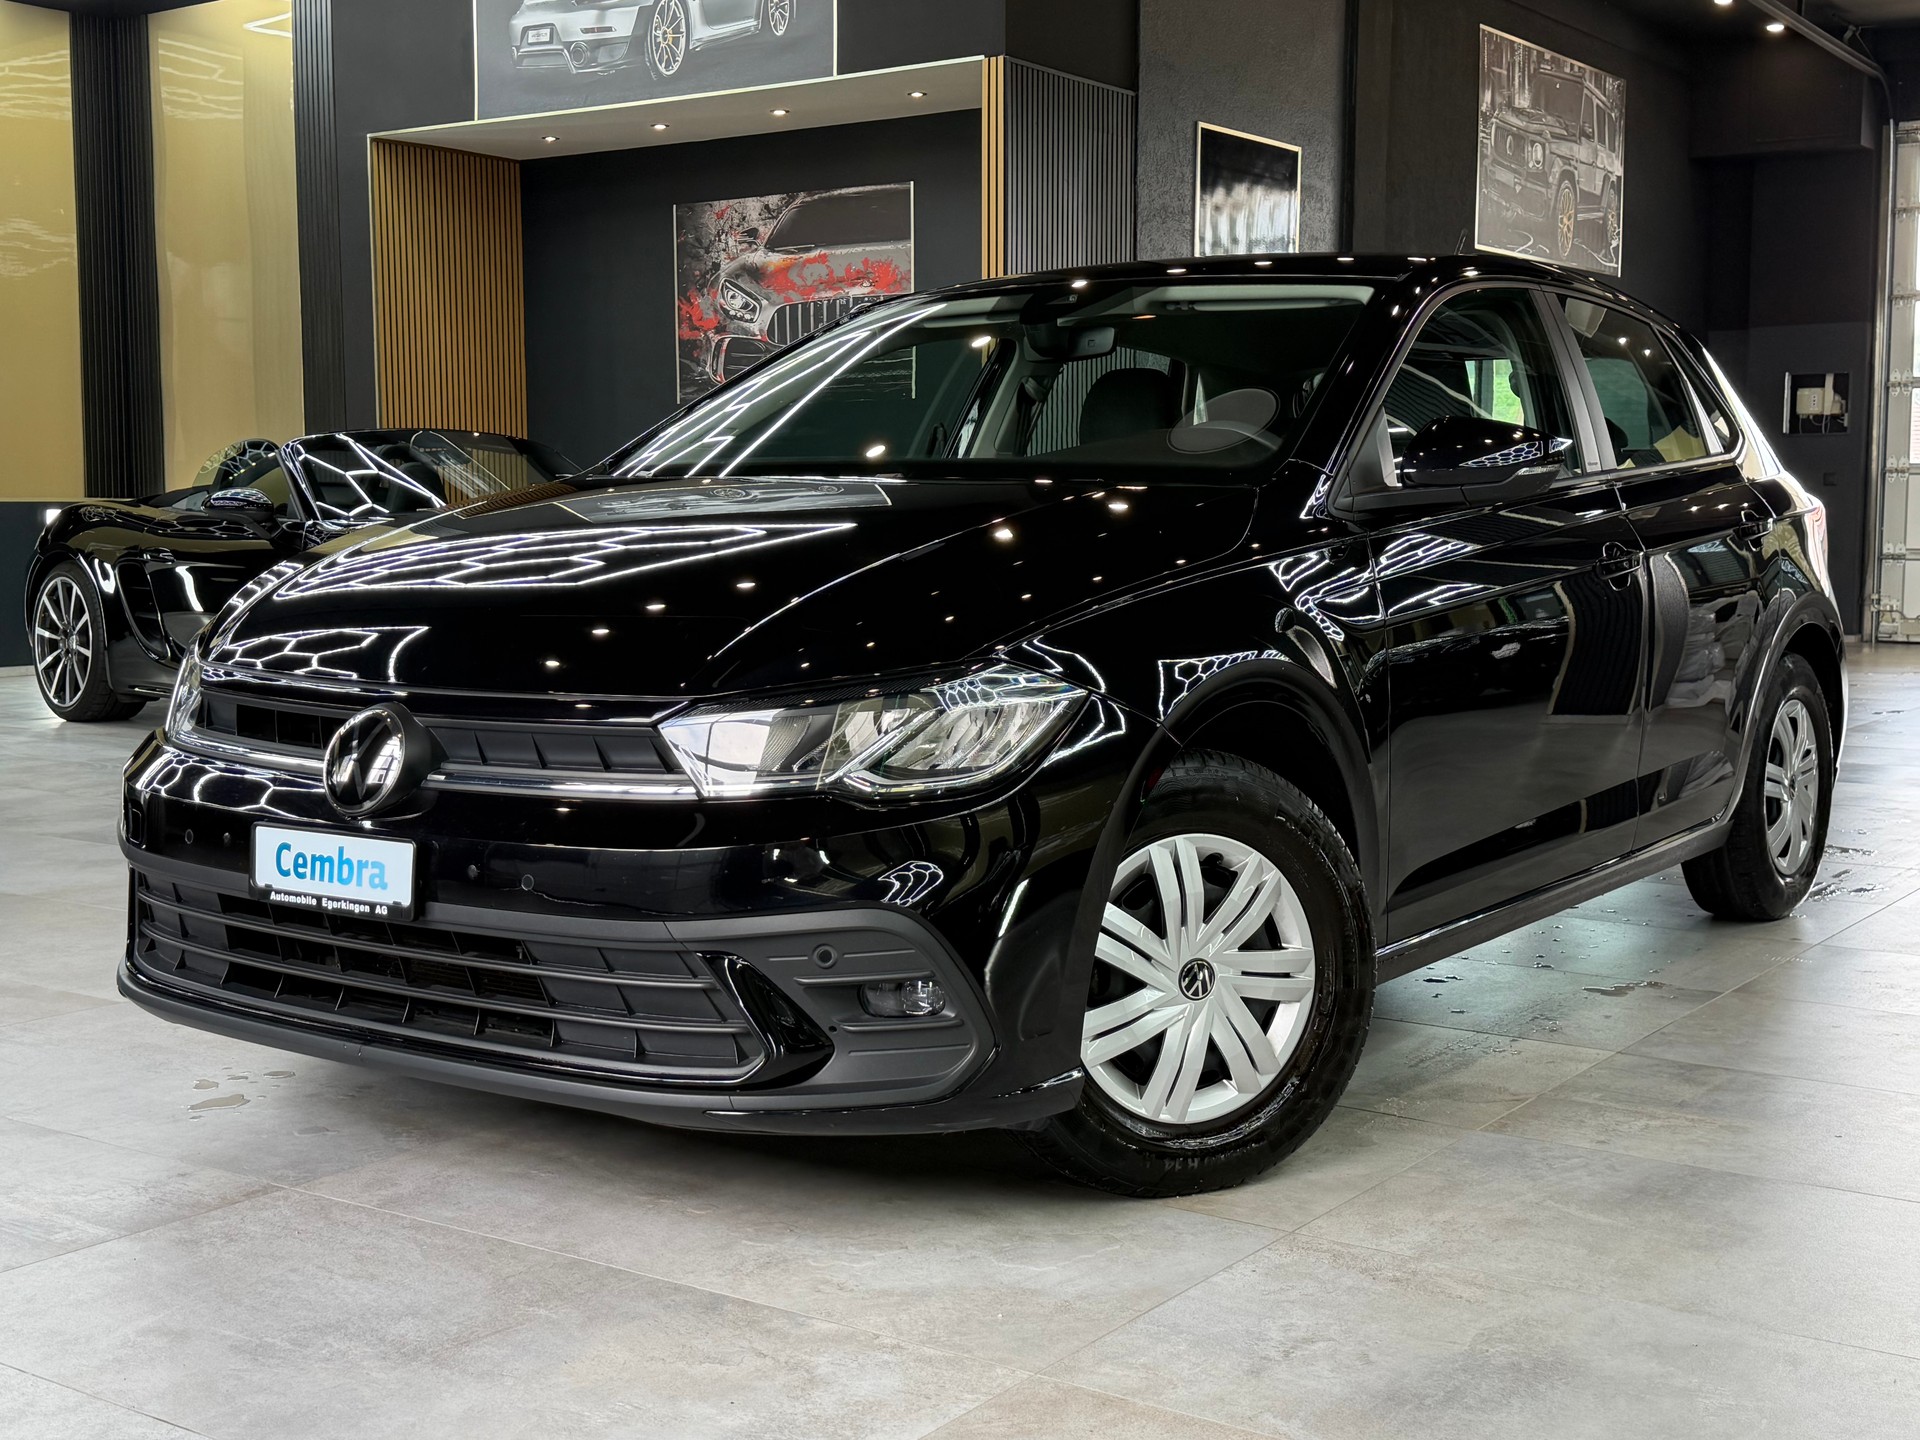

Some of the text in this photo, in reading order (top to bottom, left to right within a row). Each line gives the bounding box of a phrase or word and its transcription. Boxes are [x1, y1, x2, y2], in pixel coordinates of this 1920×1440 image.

[275, 841, 389, 891] Cembra
[270, 891, 388, 915] Automobile Egerkingen AG
